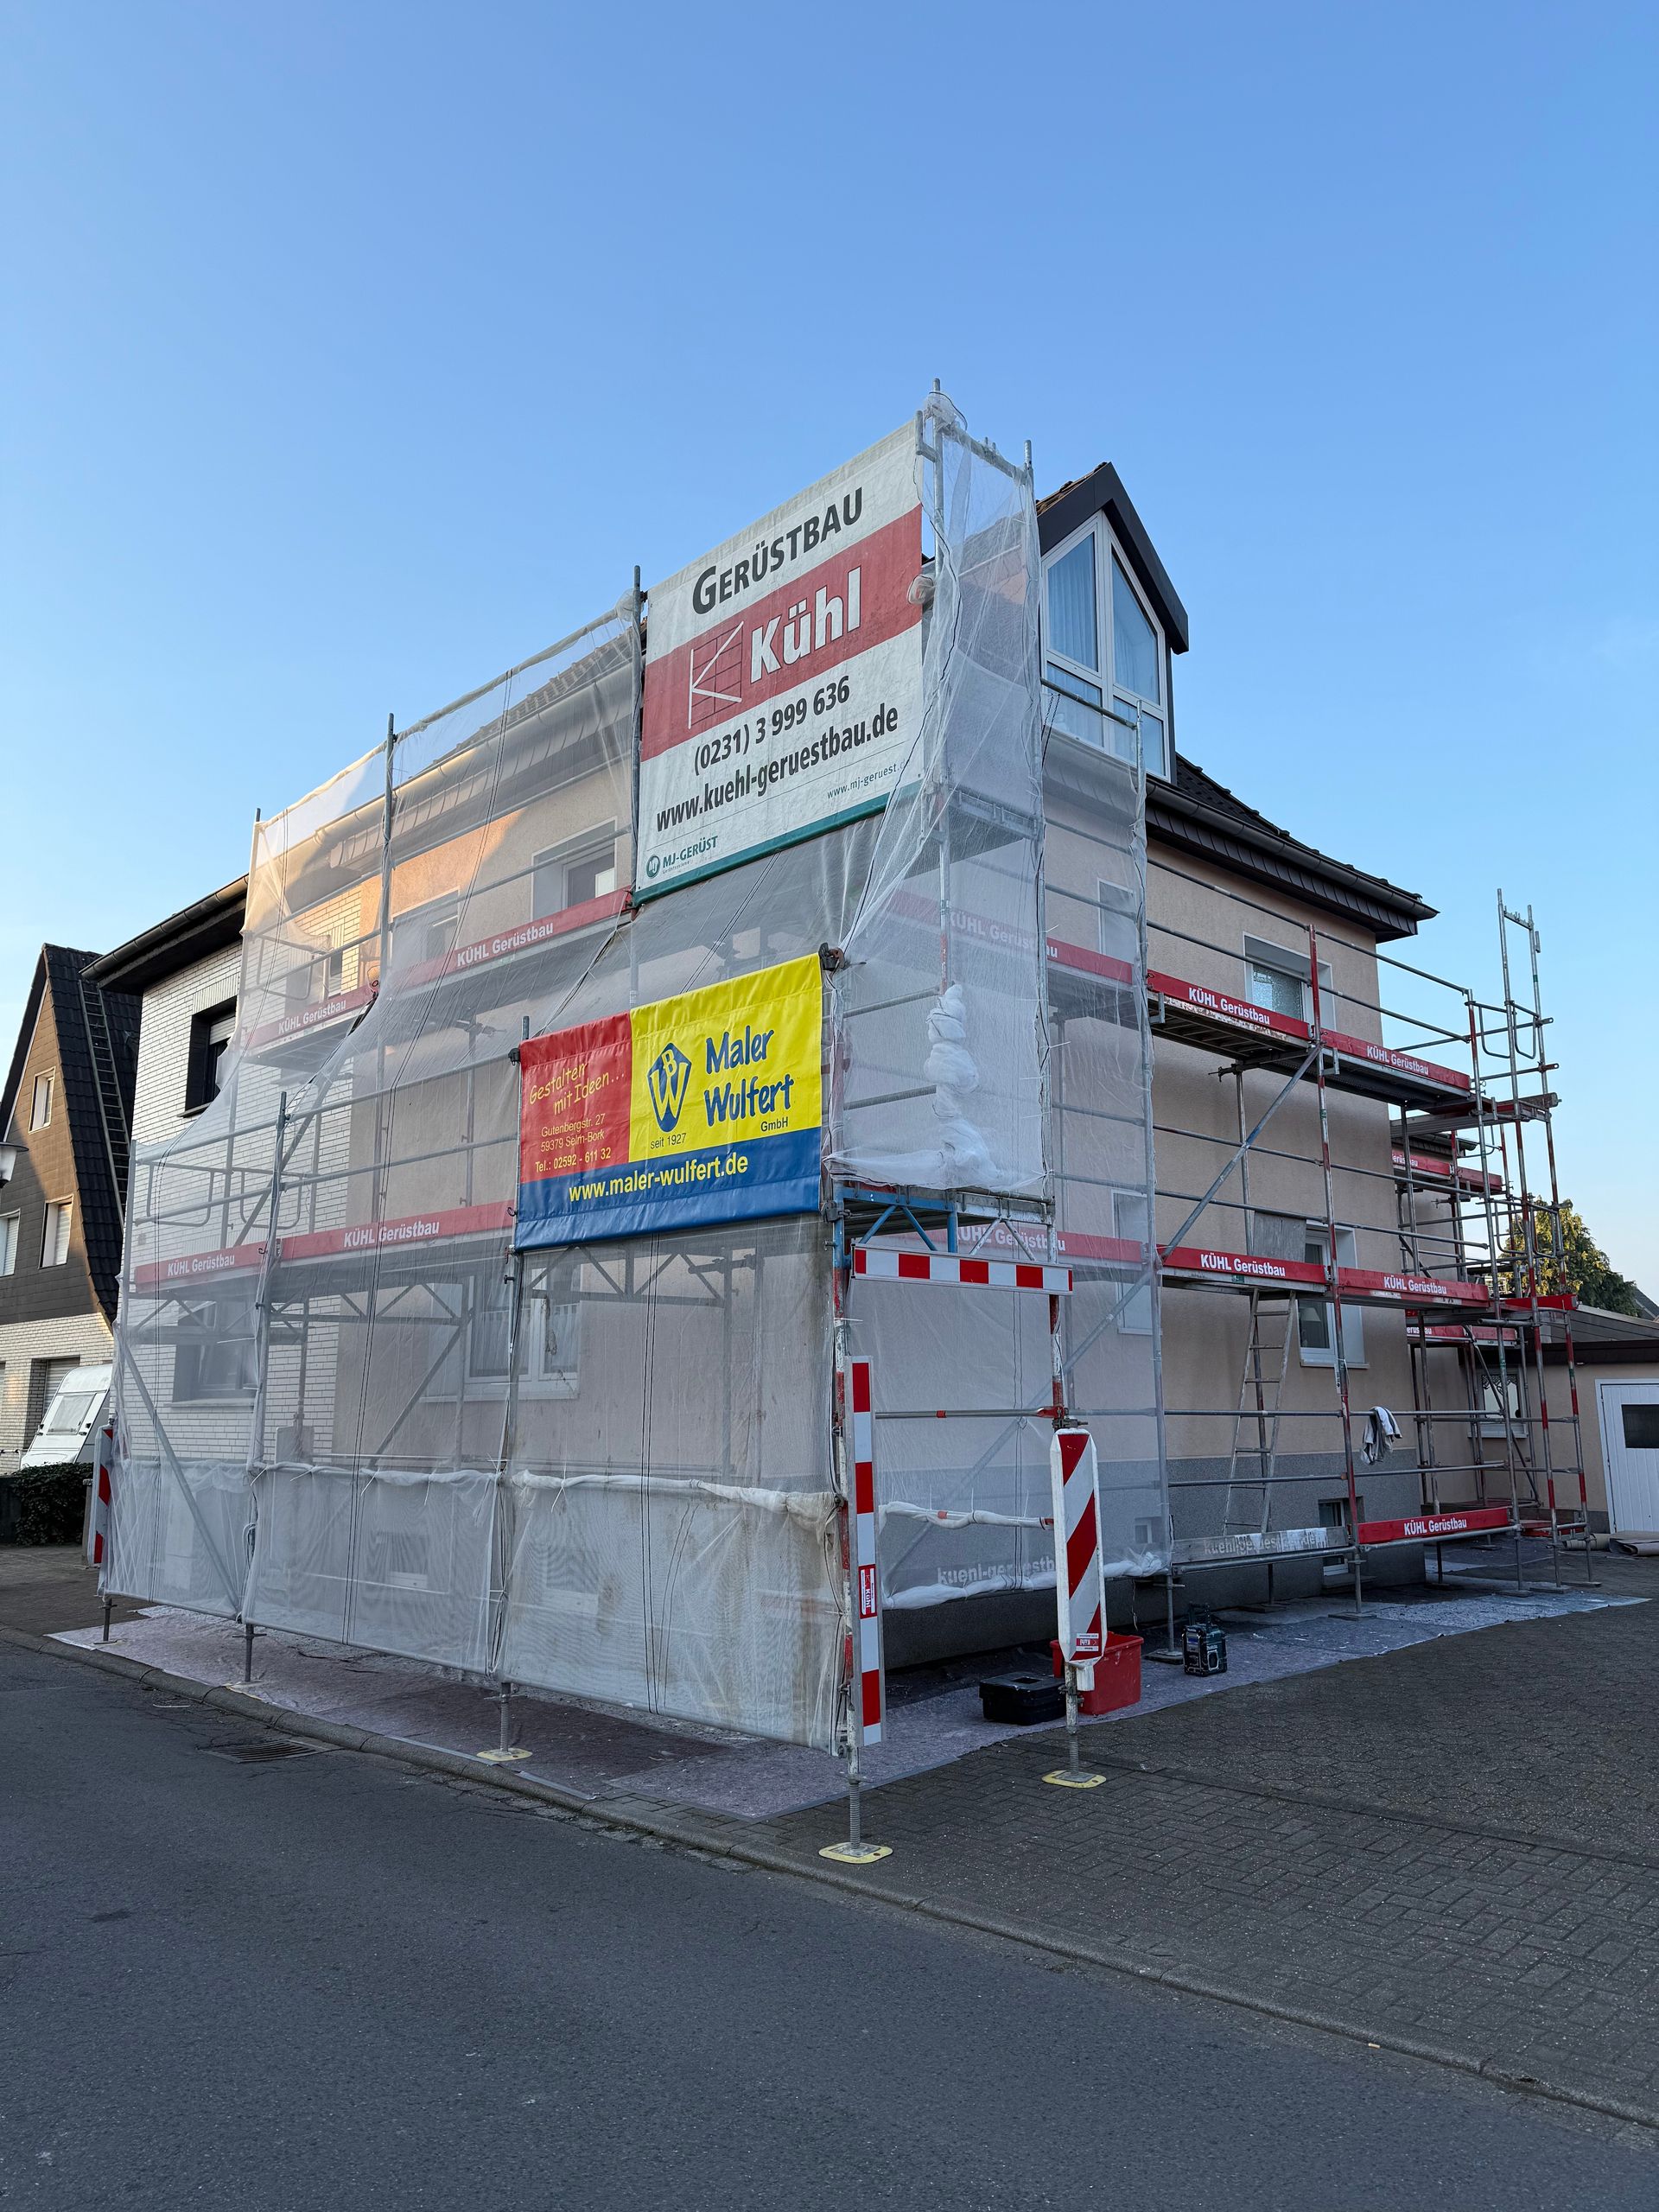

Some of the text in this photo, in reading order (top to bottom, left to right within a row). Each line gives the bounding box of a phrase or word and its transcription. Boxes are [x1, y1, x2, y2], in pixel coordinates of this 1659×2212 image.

[692, 486, 862, 614] GERÜSTBAU
[750, 566, 861, 683] Kühl
[694, 676, 849, 775] (0231) 3 999 636
[657, 703, 898, 832] www.kuehl-geruestbau.de
[663, 836, 718, 868] MJ-GERÜST
[457, 923, 553, 967] KÜHL Gerüstbau
[278, 1000, 346, 1034] KÜHL Gerüstbau
[1188, 987, 1270, 1025] KÜHL Gerüstbau
[705, 1025, 774, 1075] Maler
[1367, 1046, 1429, 1076] KÜHL Gerüstbau
[554, 1090, 573, 1116] mit
[703, 1073, 794, 1128] Wulfert
[541, 1113, 605, 1137] Gutenbergstr. 27
[760, 1116, 789, 1132] GmbH
[541, 1129, 605, 1153] 59379 Selm-Bork
[650, 1133, 687, 1149] seit 1927
[535, 1160, 551, 1173] Tel.:
[553, 1154, 577, 1169] 02592
[585, 1149, 598, 1163] 611
[601, 1147, 611, 1160] 32
[569, 1152, 748, 1202] www.maler-wulfert.de
[344, 1221, 440, 1248] KÜHL Gerüstbau
[168, 1254, 235, 1276] KÜHL Gerüstbau
[1200, 1252, 1286, 1277] KÜHL Gerüstbau
[1383, 1274, 1447, 1294] KÜHL Gerüstbau
[1403, 1517, 1467, 1535] KÜHL Gerüstbau
